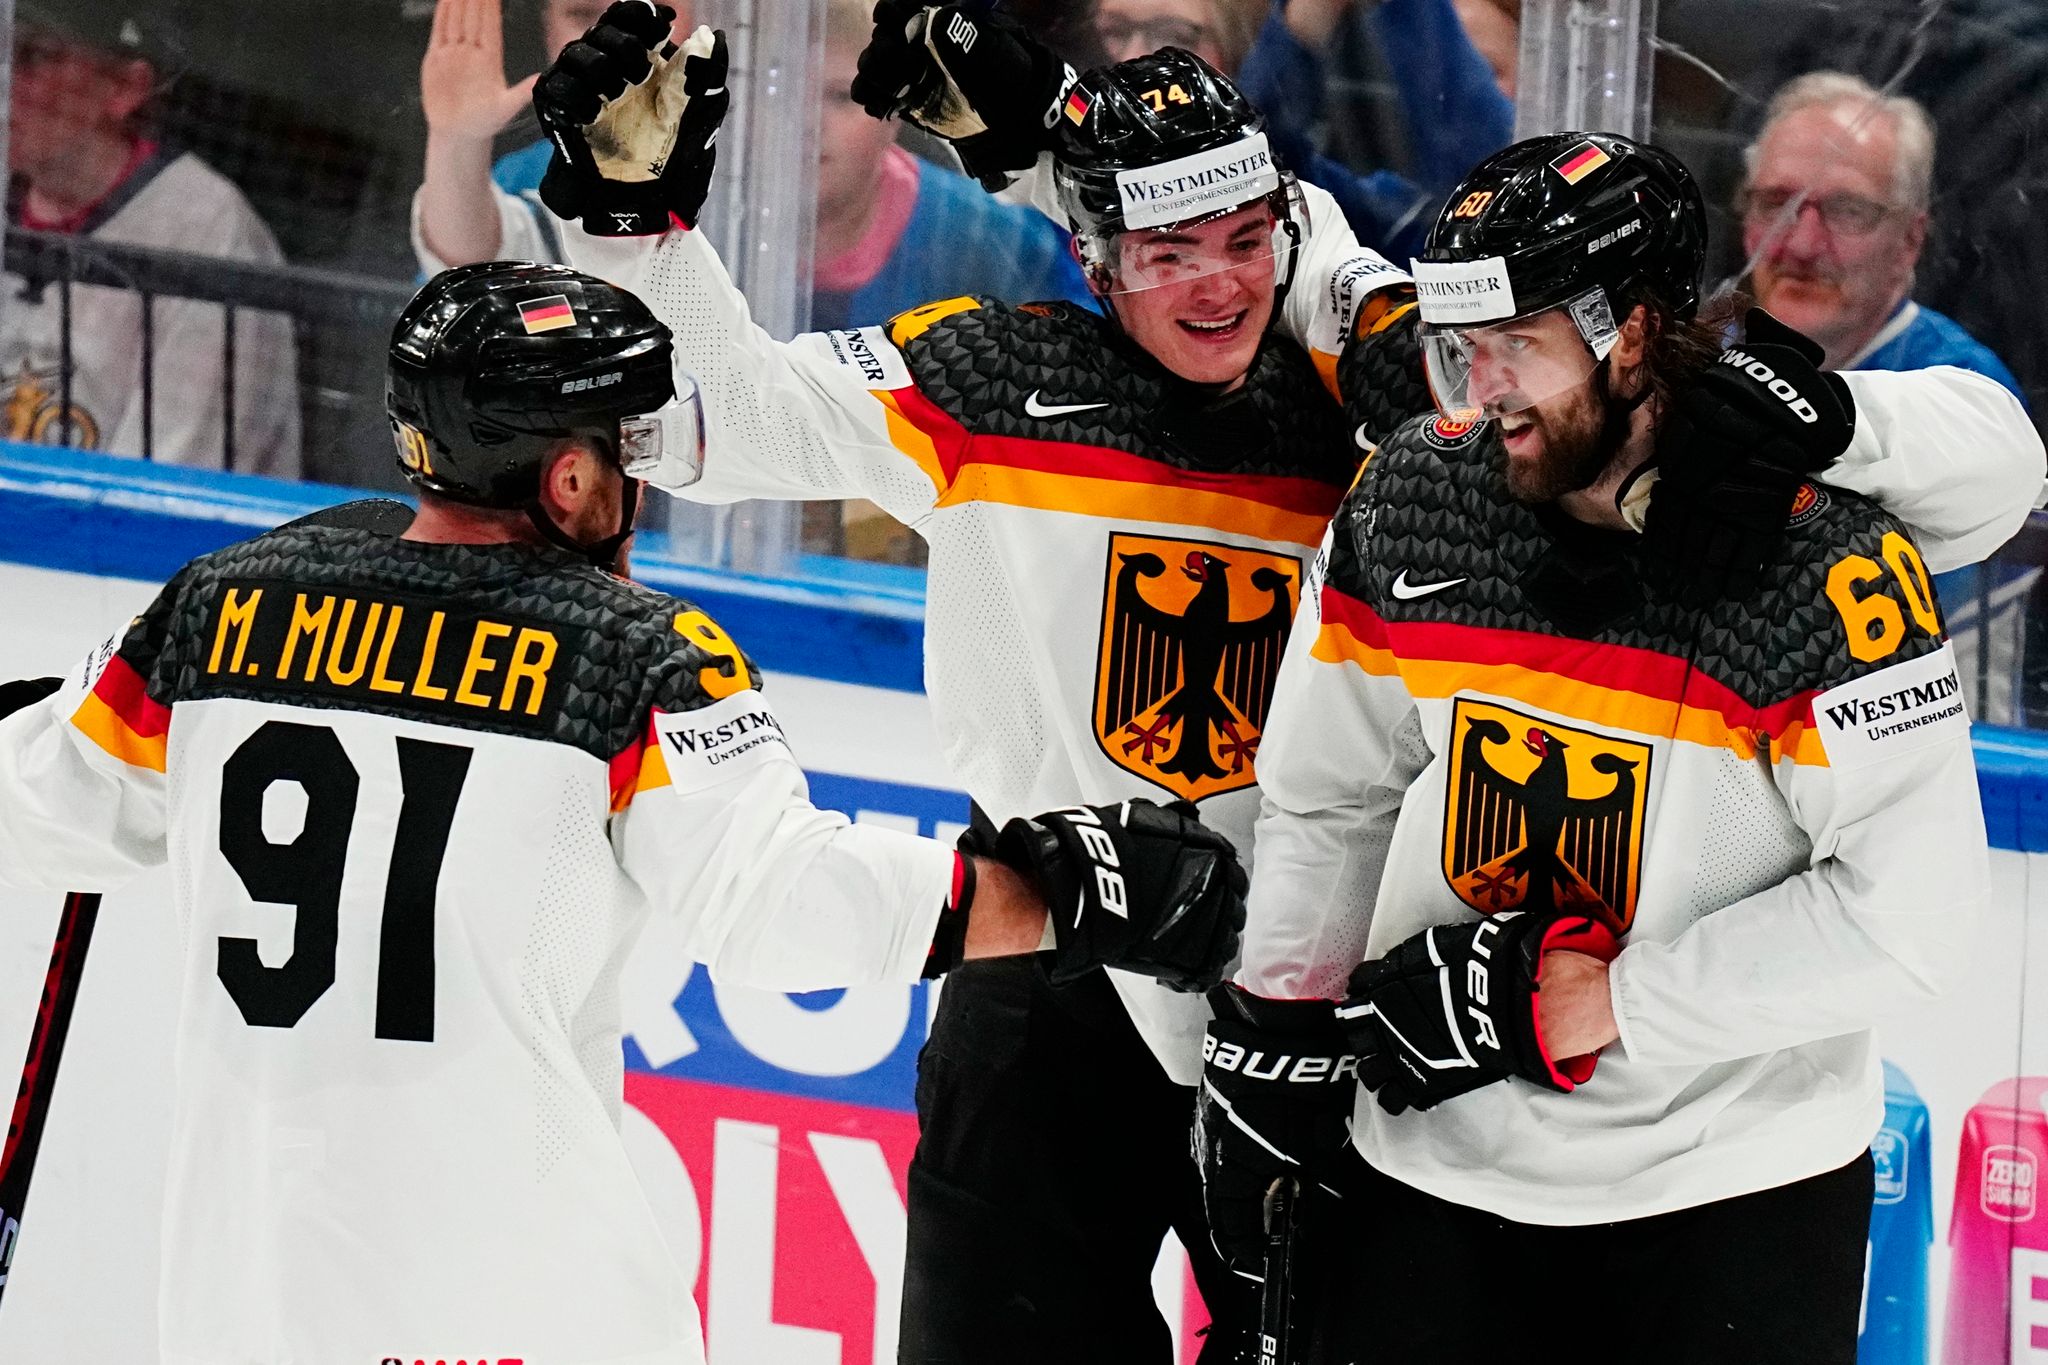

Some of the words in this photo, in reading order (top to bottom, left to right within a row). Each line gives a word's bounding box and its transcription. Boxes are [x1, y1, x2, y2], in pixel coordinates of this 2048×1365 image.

[1140, 84, 1191, 112] 74
[1123, 151, 1268, 202] WESTMINSTER
[1455, 191, 1493, 217] 60
[1825, 530, 1941, 663] 60
[207, 588, 264, 677] M.
[276, 592, 559, 716] MULLER
[216, 719, 475, 1043] 91
[1987, 1158, 2033, 1188] ZERO
